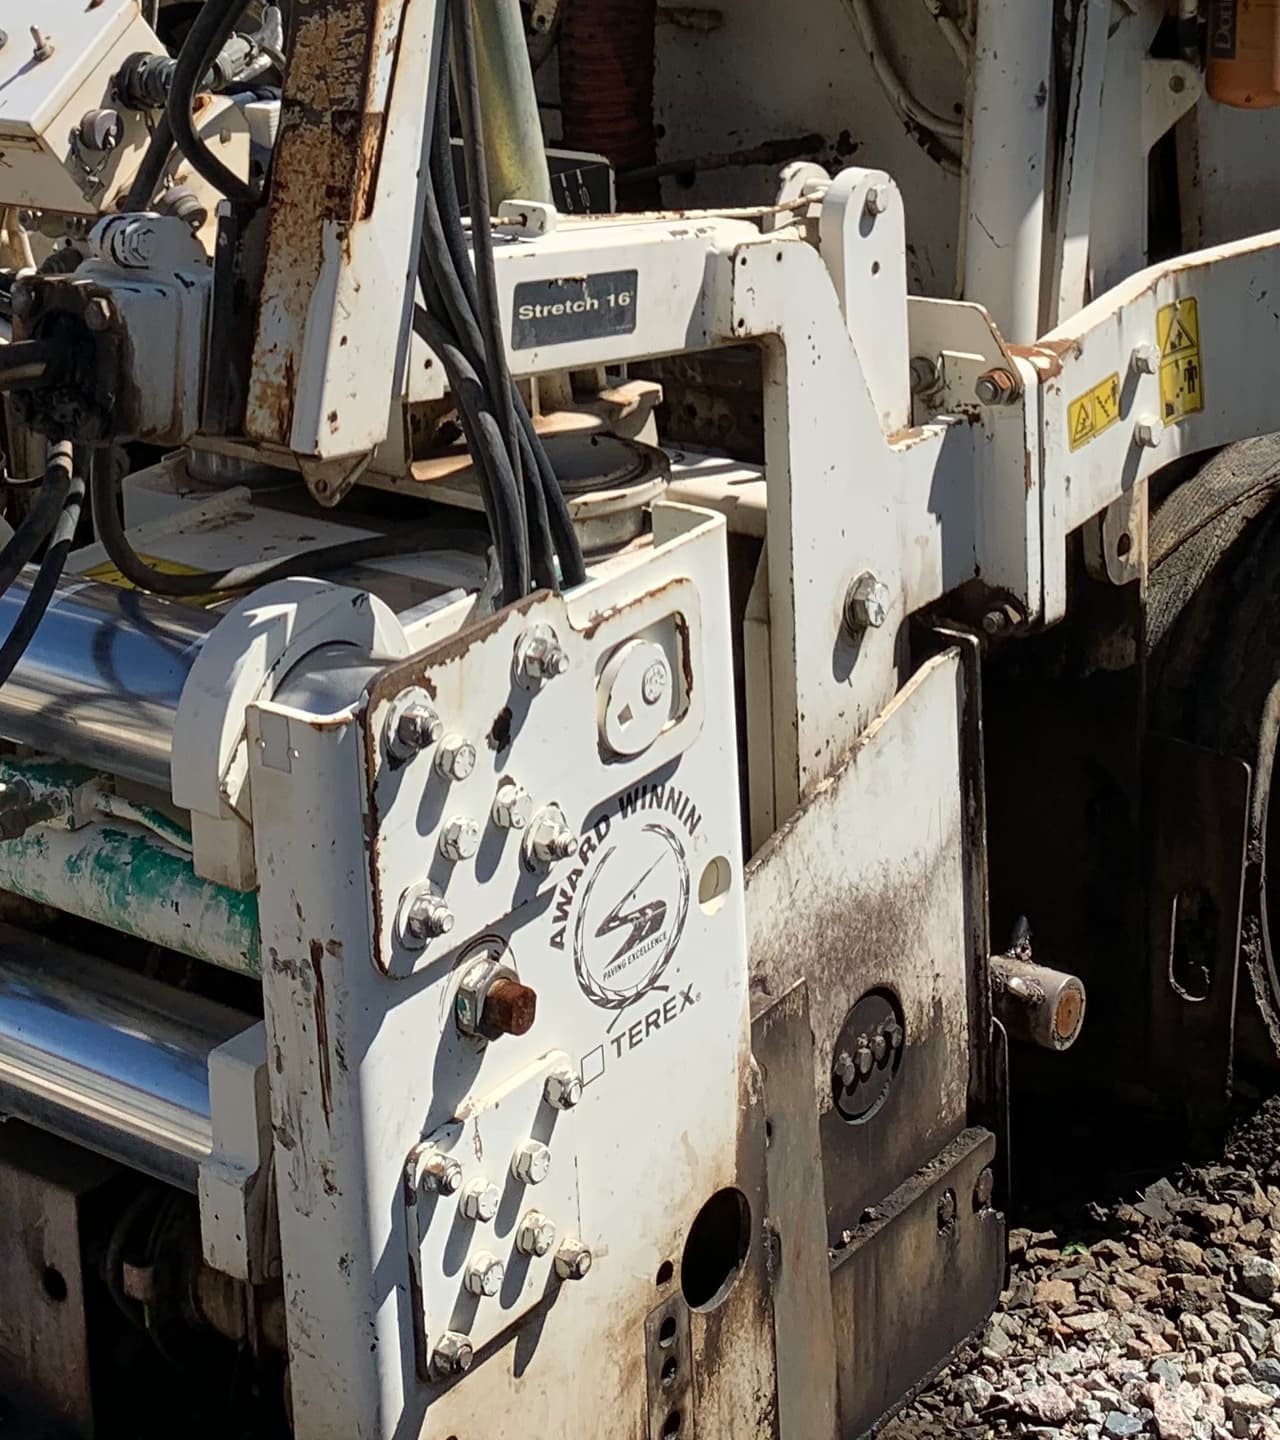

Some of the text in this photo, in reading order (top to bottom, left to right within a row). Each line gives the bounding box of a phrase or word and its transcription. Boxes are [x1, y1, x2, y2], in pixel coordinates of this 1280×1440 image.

[518, 296, 599, 320] Stretch
[549, 782, 706, 952] AWARD WINNIN
[602, 930, 668, 983] PAVING EXCELLENCE
[610, 982, 696, 1059] TEREX
